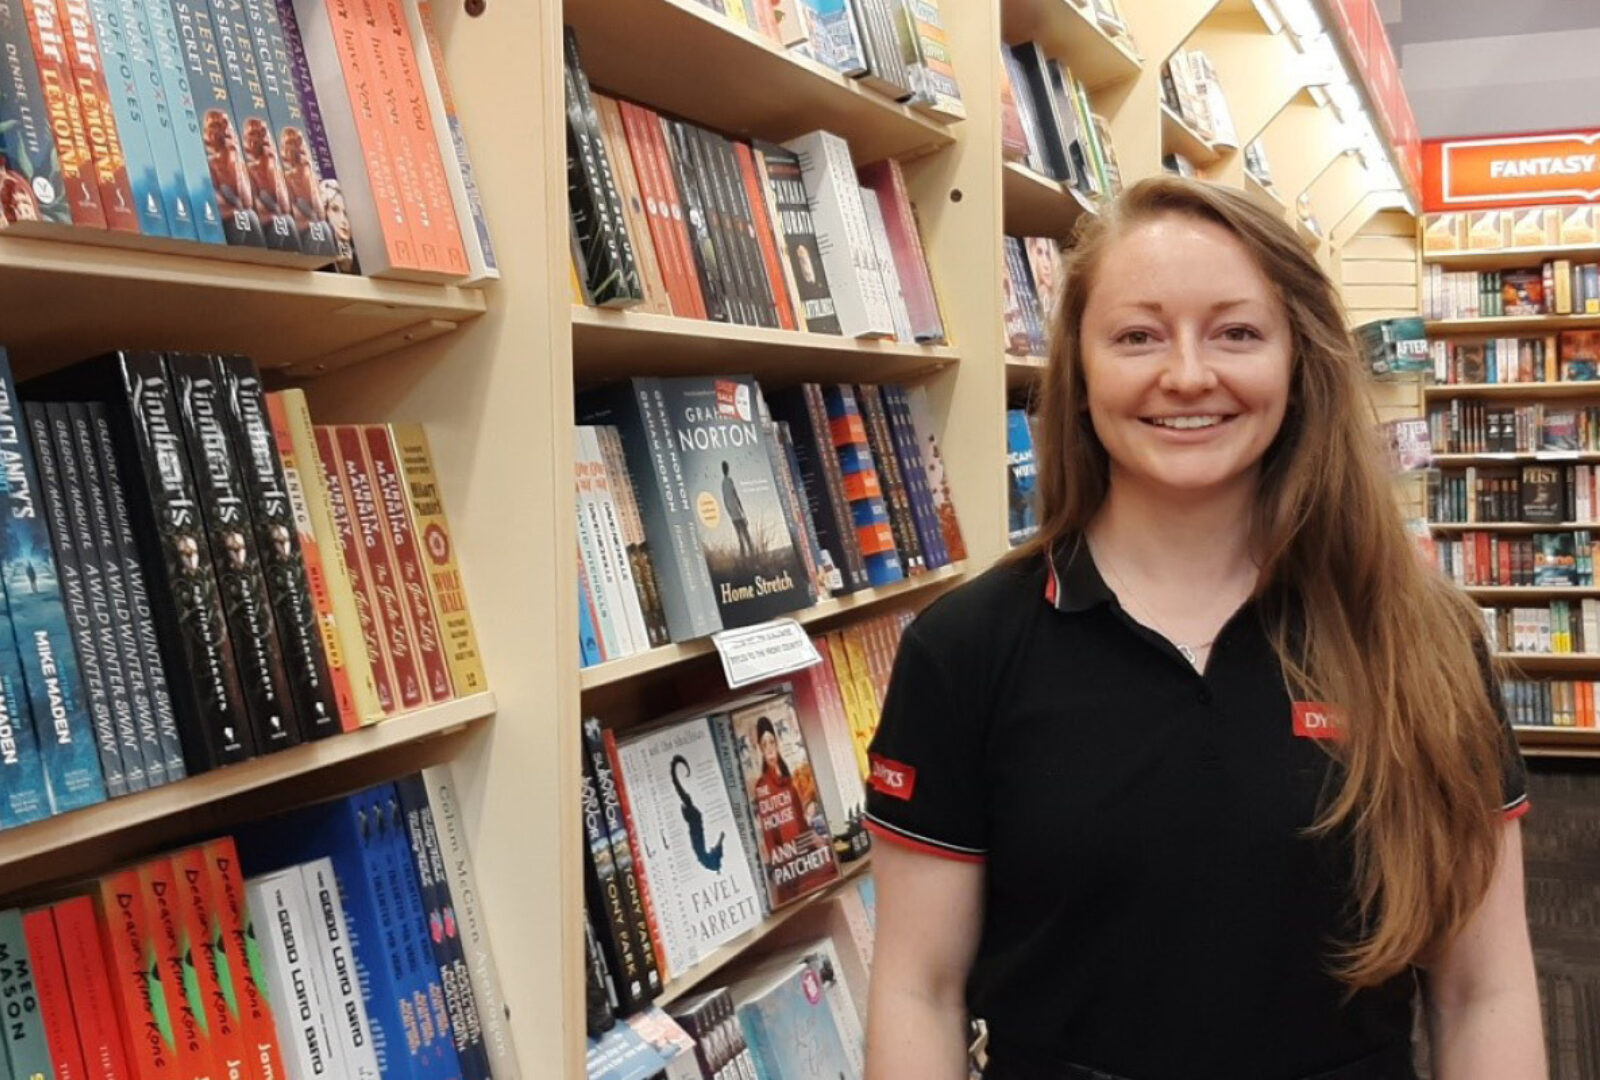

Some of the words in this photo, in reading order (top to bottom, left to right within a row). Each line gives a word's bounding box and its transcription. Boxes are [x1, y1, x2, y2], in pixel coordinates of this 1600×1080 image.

[33, 0, 62, 63] fair
[67, 0, 97, 72] fair
[176, 3, 204, 74] SECRET
[194, 11, 227, 101] LESTER
[217, 15, 243, 85] SECRET
[254, 26, 280, 97] SECRET
[5, 43, 28, 103] DENISE
[107, 13, 121, 41] OF
[118, 52, 142, 123] FOXES
[138, 18, 150, 42] OF
[147, 59, 169, 129] FOXES
[235, 23, 265, 110] LESTER
[270, 34, 299, 119] LESTER
[397, 46, 416, 88] have
[42, 69, 80, 179] LEMOINE
[78, 78, 116, 184] LEMOINE
[175, 65, 198, 134] FOXES
[308, 101, 333, 169] LESTER
[1491, 155, 1597, 178] FANTASY
[368, 150, 389, 200] LEVIN
[397, 156, 415, 204] LEVIN
[423, 163, 440, 209] LEVIN
[581, 134, 600, 196] PLEASE
[599, 203, 610, 231] SEE
[608, 240, 618, 259] US
[596, 138, 616, 198] PLEASE
[613, 206, 625, 234] SEE
[624, 242, 633, 261] US
[1397, 340, 1428, 356] AFTER
[641, 390, 660, 451] GRAHAM
[656, 453, 676, 513] NORTON
[654, 390, 673, 449] GRAHAM
[670, 452, 690, 511] NORTON
[678, 423, 758, 452] NORTON
[1010, 449, 1033, 464] CAN
[34, 420, 56, 481] GREGORY
[48, 485, 71, 550] MAGUIRE
[56, 419, 78, 480] GREGORY
[70, 482, 93, 549] MAGUIRE
[76, 419, 97, 480] GREGORY
[91, 482, 113, 547] MAGUIRE
[97, 418, 118, 478] GREGORY
[112, 482, 133, 544] MAGUIRE
[329, 475, 352, 536] KIRSTY
[346, 460, 375, 548] MANNING
[357, 473, 380, 533] KIRSTY
[375, 460, 404, 546] MANNING
[387, 473, 408, 531] KIRSTY
[63, 564, 78, 577] A
[85, 563, 99, 575] A
[107, 561, 119, 572] A
[127, 557, 139, 570] A
[130, 572, 150, 617] WILD
[588, 551, 607, 619] NICHOLLS
[721, 580, 754, 604] Home
[755, 571, 793, 597] Stretch
[66, 580, 89, 628] WILD
[87, 578, 110, 624] WILD
[109, 576, 130, 622] WILD
[287, 571, 303, 623] NATHAN
[79, 631, 104, 700] WINTER
[101, 627, 126, 696] WINTER
[122, 623, 145, 696] WINTER
[139, 617, 166, 687] WINTER
[34, 631, 56, 676] MIKE
[45, 678, 72, 745] MADEN
[134, 695, 158, 745] SWAN
[154, 689, 178, 740] SWAN
[1305, 712, 1328, 728] DY
[95, 703, 117, 755] SWAN
[116, 699, 138, 752] SWAN
[759, 791, 792, 814] DUTCH
[763, 810, 794, 831] HOUSE
[440, 786, 458, 852] Colum
[456, 861, 480, 944] McCann
[771, 838, 798, 866] ANN
[774, 846, 832, 886] PATCHETT
[606, 873, 624, 924] TONY
[620, 928, 637, 976] PARK
[625, 867, 642, 914] TONY
[638, 920, 654, 965] PARK
[687, 896, 756, 942] ARRETT
[691, 875, 741, 912] FAVEL
[0, 943, 26, 1041] MASON
[14, 959, 36, 1013] MEG
[277, 909, 298, 964] GOOD
[292, 968, 311, 1021] LORD
[304, 1026, 324, 1076] BIRD
[319, 890, 339, 942] GOOD
[332, 946, 351, 996] LORD
[345, 1001, 364, 1048] BIRD
